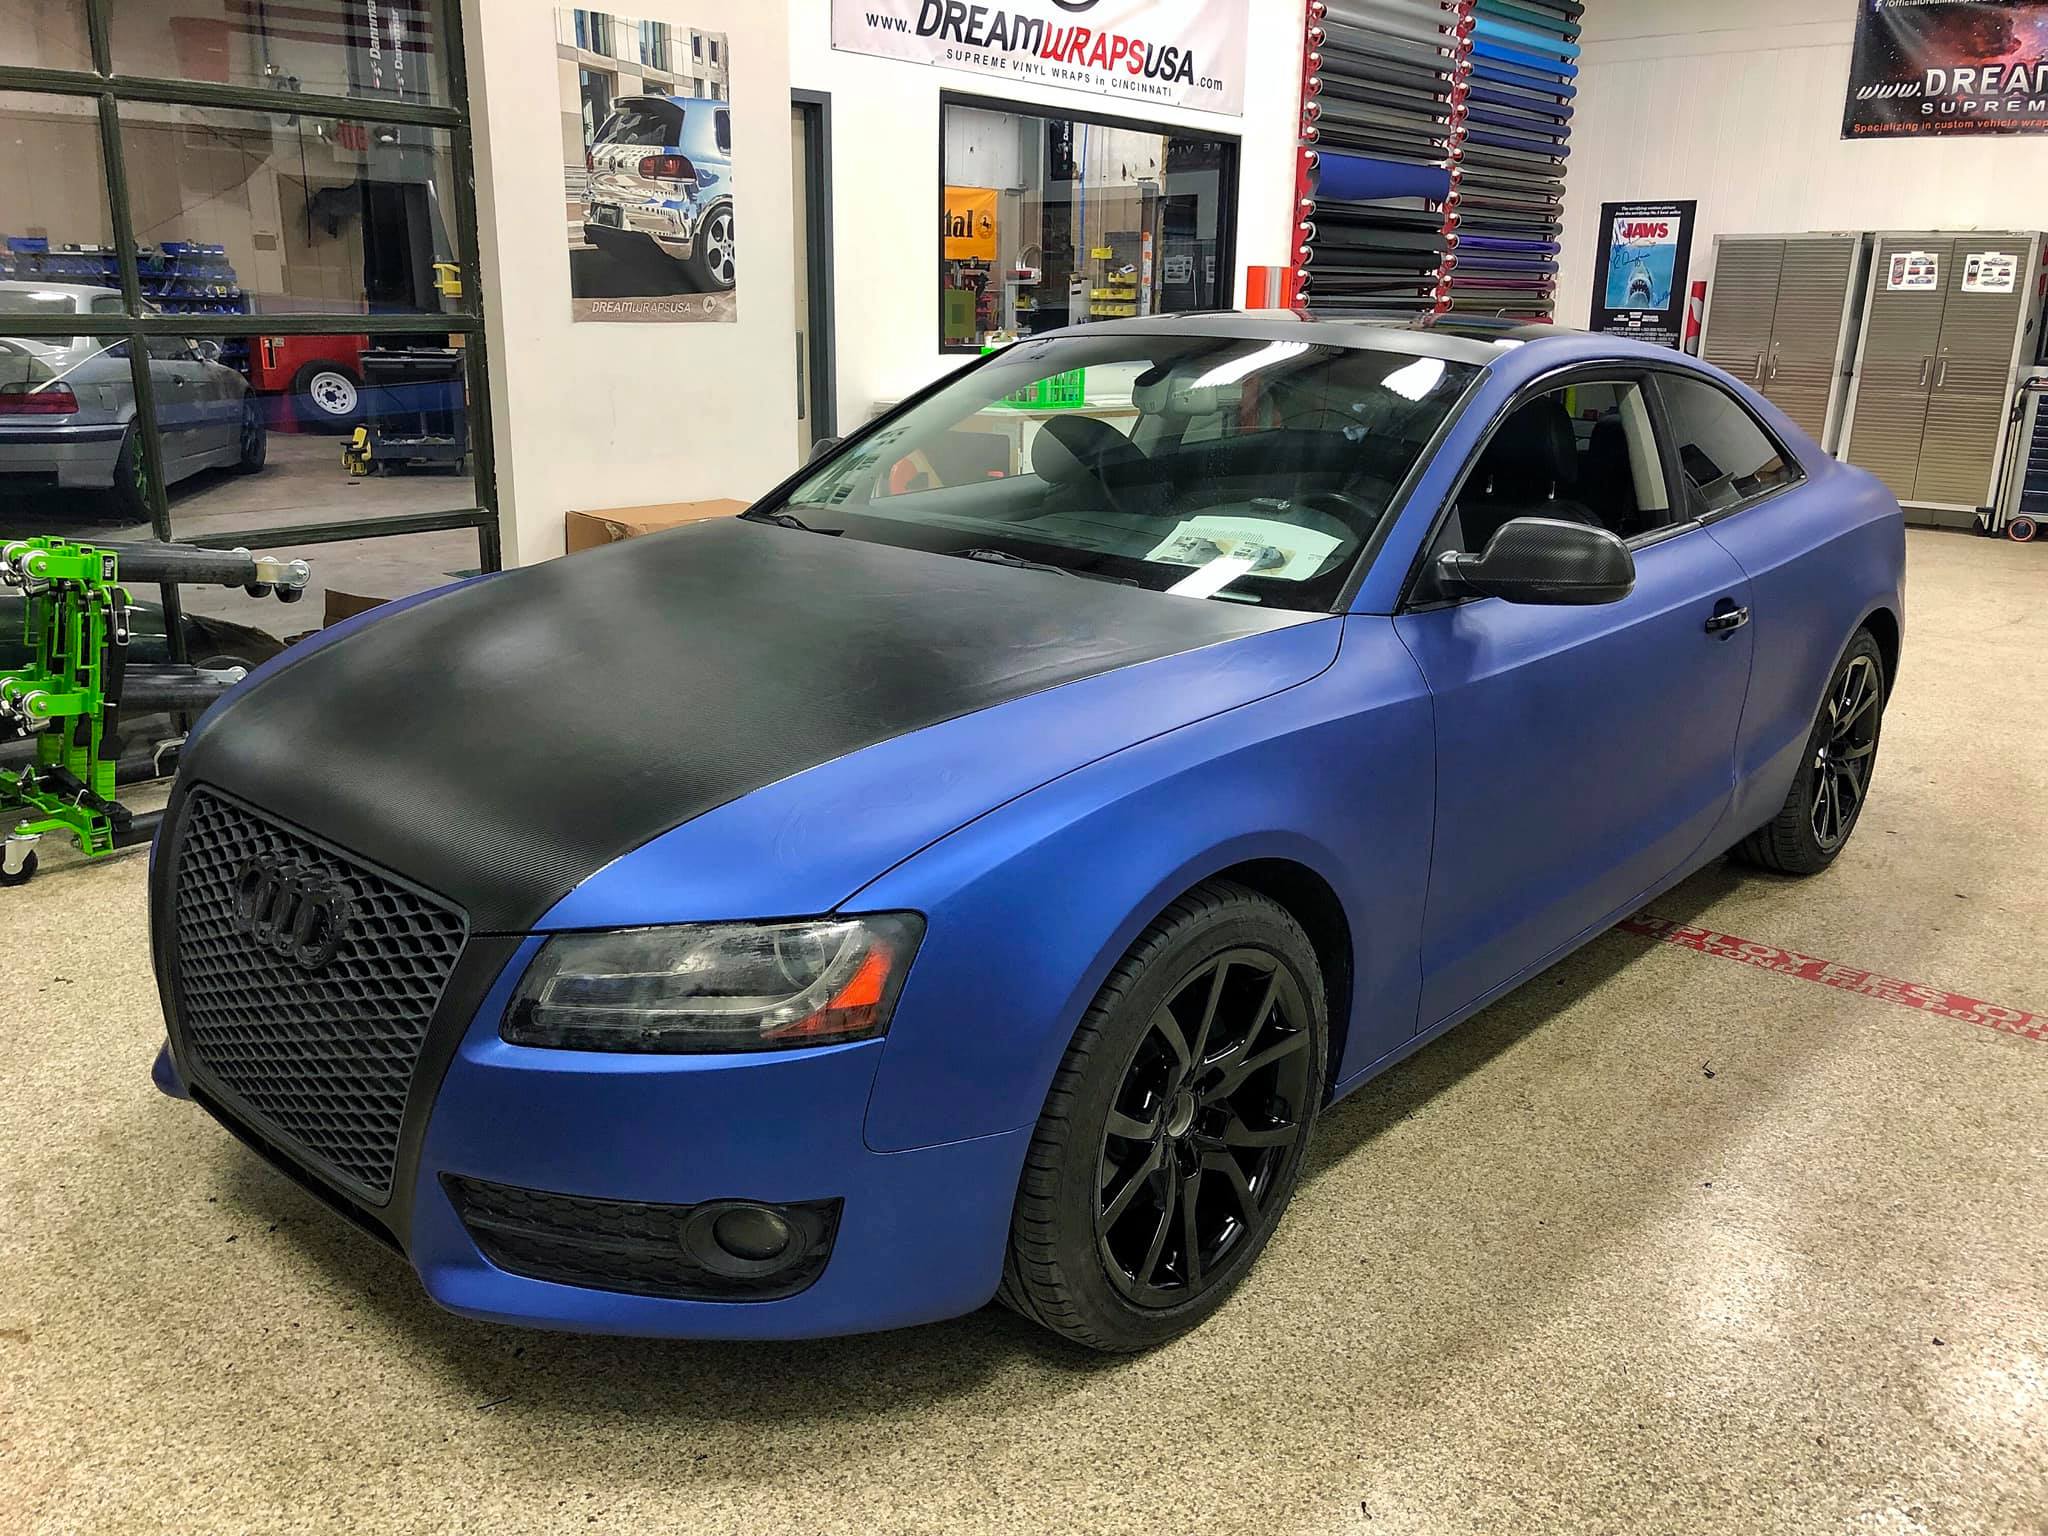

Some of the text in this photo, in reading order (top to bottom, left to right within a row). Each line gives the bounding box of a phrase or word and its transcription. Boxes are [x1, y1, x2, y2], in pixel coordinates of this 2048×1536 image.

[946, 48, 1172, 97] SUPREME VINYL WRAPS in CINCINNATI
[1921, 100, 2046, 114] SUPREM
[1854, 121, 1918, 133] Specializing
[1922, 121, 1932, 129] in
[1935, 119, 1974, 129] custom
[1977, 118, 2018, 128] vehicle
[1623, 222, 1669, 239] JAWS
[591, 301, 691, 313] DREAMWRAPSUSA
